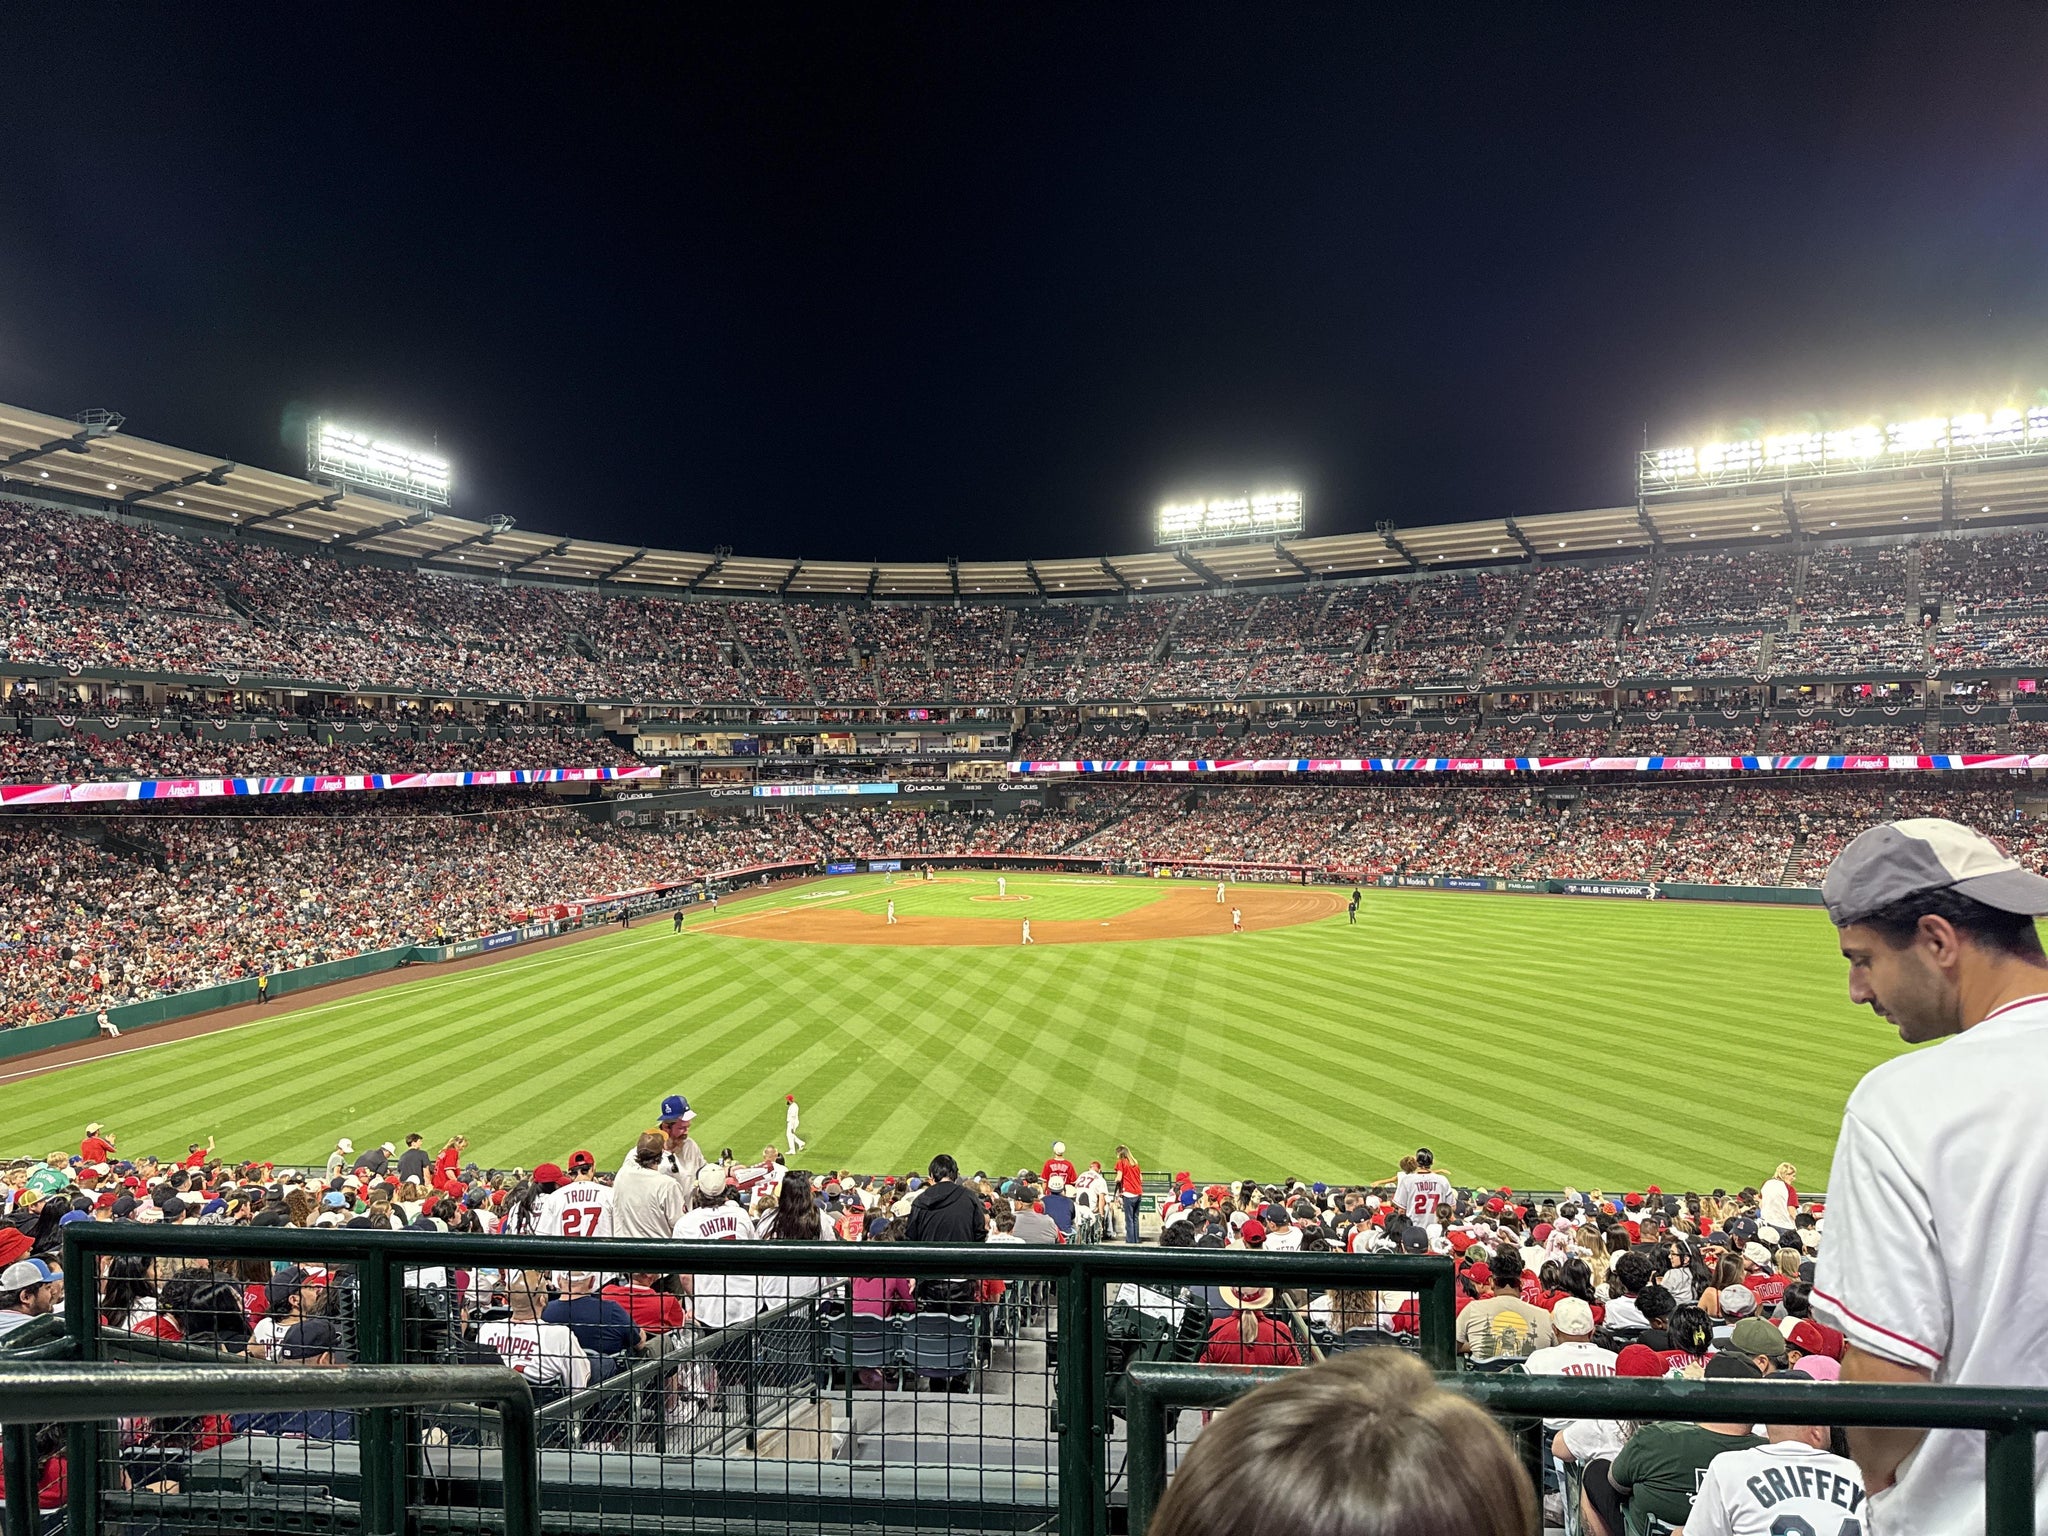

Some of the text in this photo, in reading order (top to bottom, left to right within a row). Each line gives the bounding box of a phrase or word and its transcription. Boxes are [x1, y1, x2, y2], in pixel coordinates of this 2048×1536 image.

[1674, 759, 1701, 769] Angels
[1853, 758, 1884, 769] Angels
[166, 783, 196, 797] Angels
[1406, 877, 1427, 886] Modelo
[1580, 885, 1642, 895] MLB NETWORK
[1076, 1176, 1095, 1189] 27
[1415, 1181, 1438, 1192] TROUT
[564, 1189, 600, 1204] TROUT
[1414, 1193, 1441, 1215] 27
[562, 1207, 602, 1237] 27
[699, 1216, 737, 1238] OHTANI
[1754, 1281, 1784, 1298] TROUT
[1746, 1465, 1867, 1515] GRIFFEY
